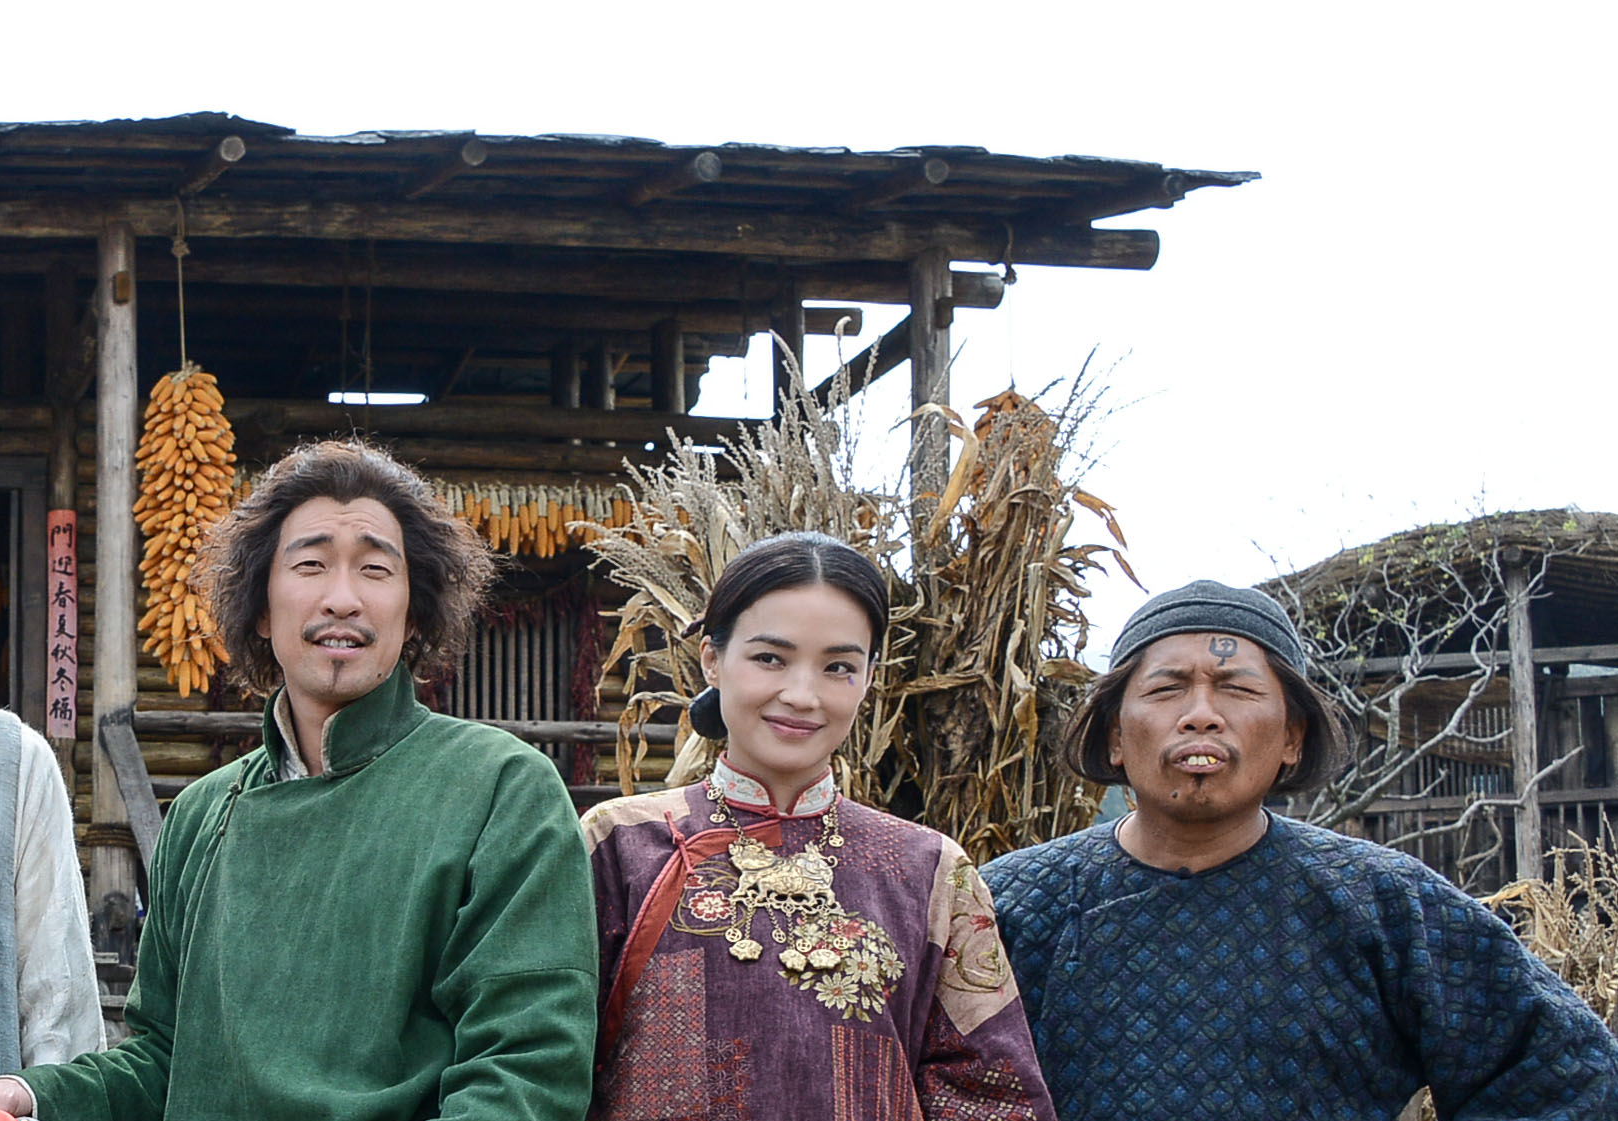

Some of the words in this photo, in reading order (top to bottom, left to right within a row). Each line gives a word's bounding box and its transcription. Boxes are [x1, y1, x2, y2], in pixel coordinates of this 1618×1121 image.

[49, 522, 76, 722] 門迎春夏秋冬福
